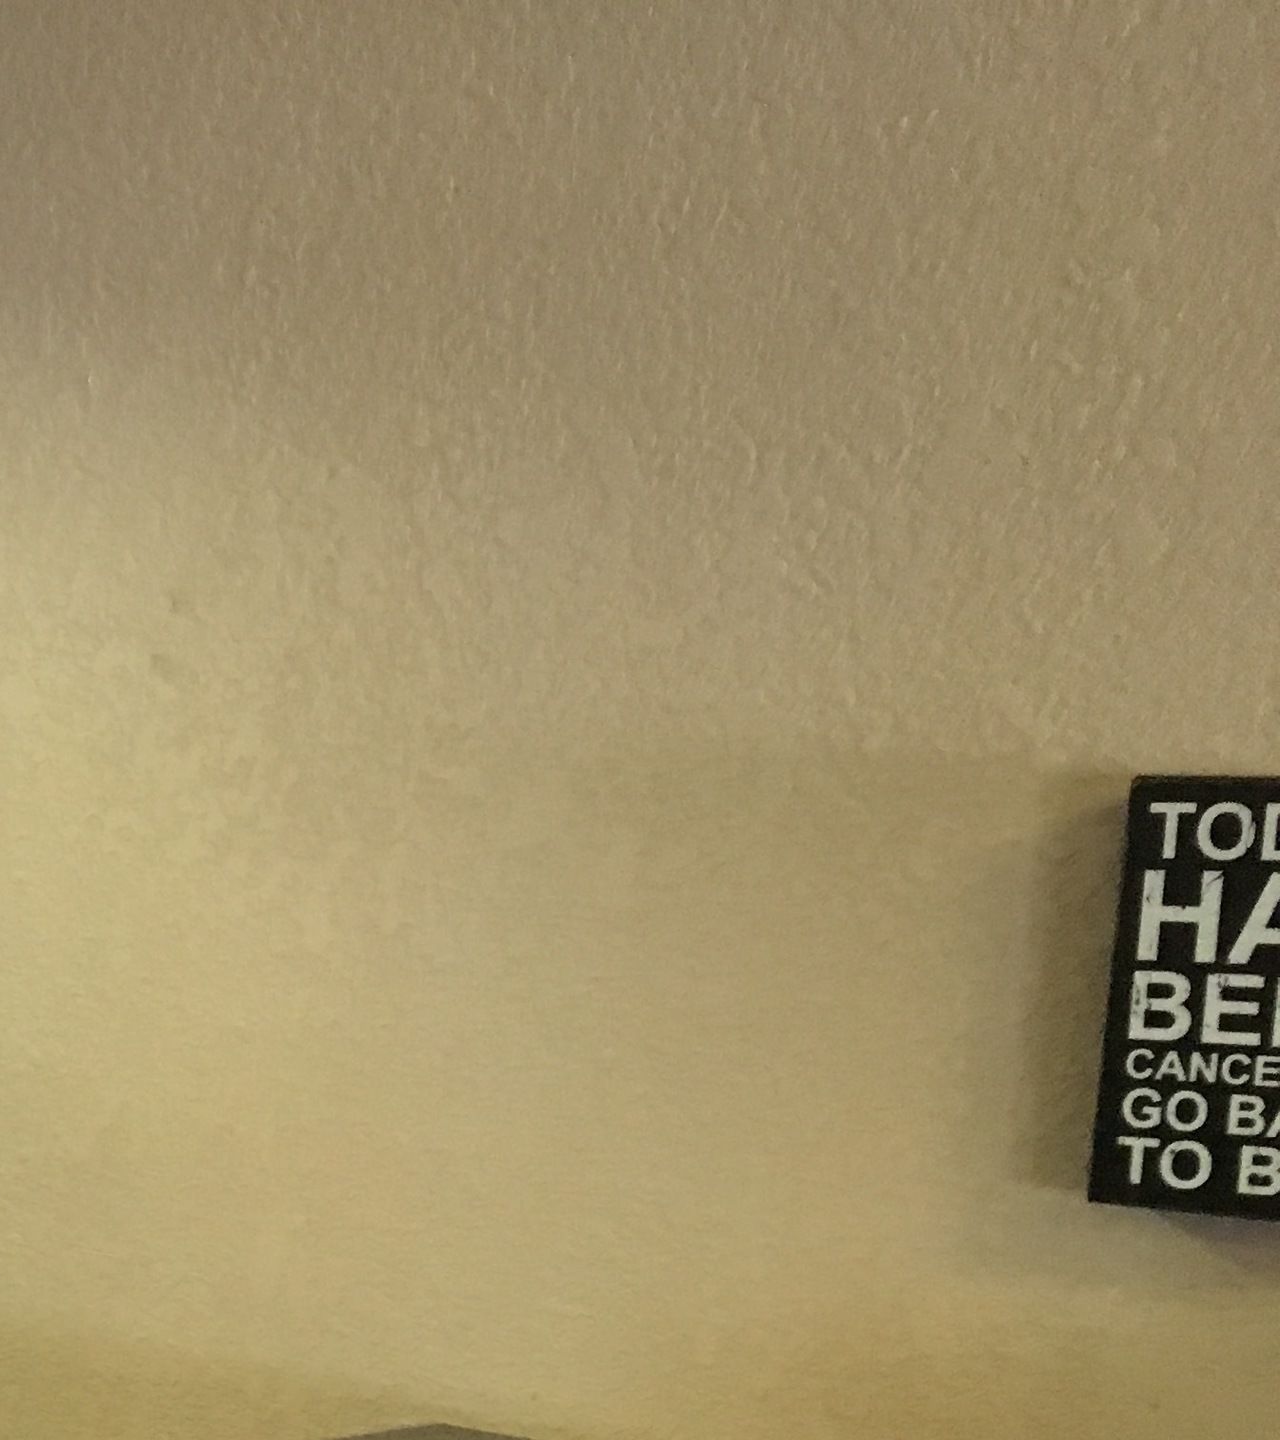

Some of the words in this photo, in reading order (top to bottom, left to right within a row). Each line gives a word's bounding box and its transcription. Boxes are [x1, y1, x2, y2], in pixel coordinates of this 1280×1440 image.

[1128, 970, 1280, 1046] BE
[1122, 1087, 1208, 1131] GO
[1226, 1093, 1280, 1137] B
[1117, 1136, 1212, 1189] TO
